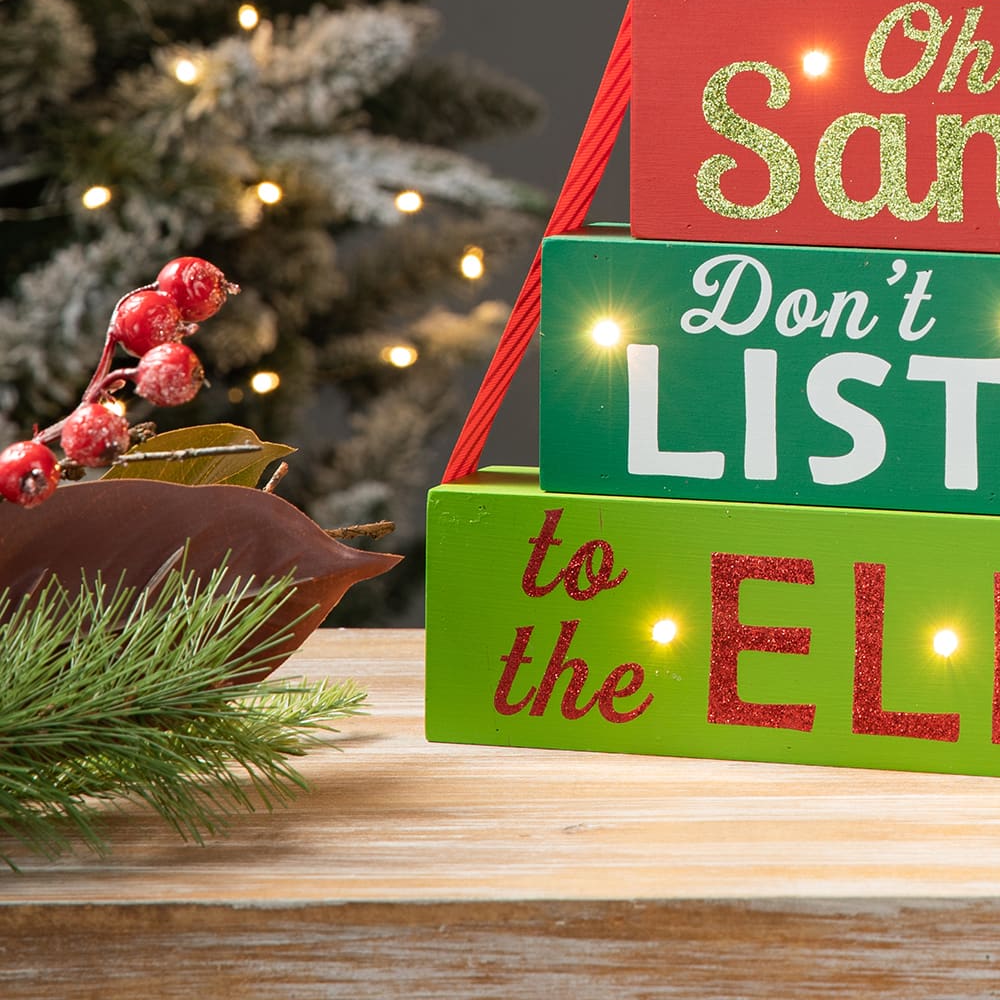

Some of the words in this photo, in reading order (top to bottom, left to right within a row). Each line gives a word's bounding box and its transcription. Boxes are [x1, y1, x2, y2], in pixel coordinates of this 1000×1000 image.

[680, 254, 936, 342] Don't
[521, 507, 628, 600] to
[493, 619, 654, 723] the
